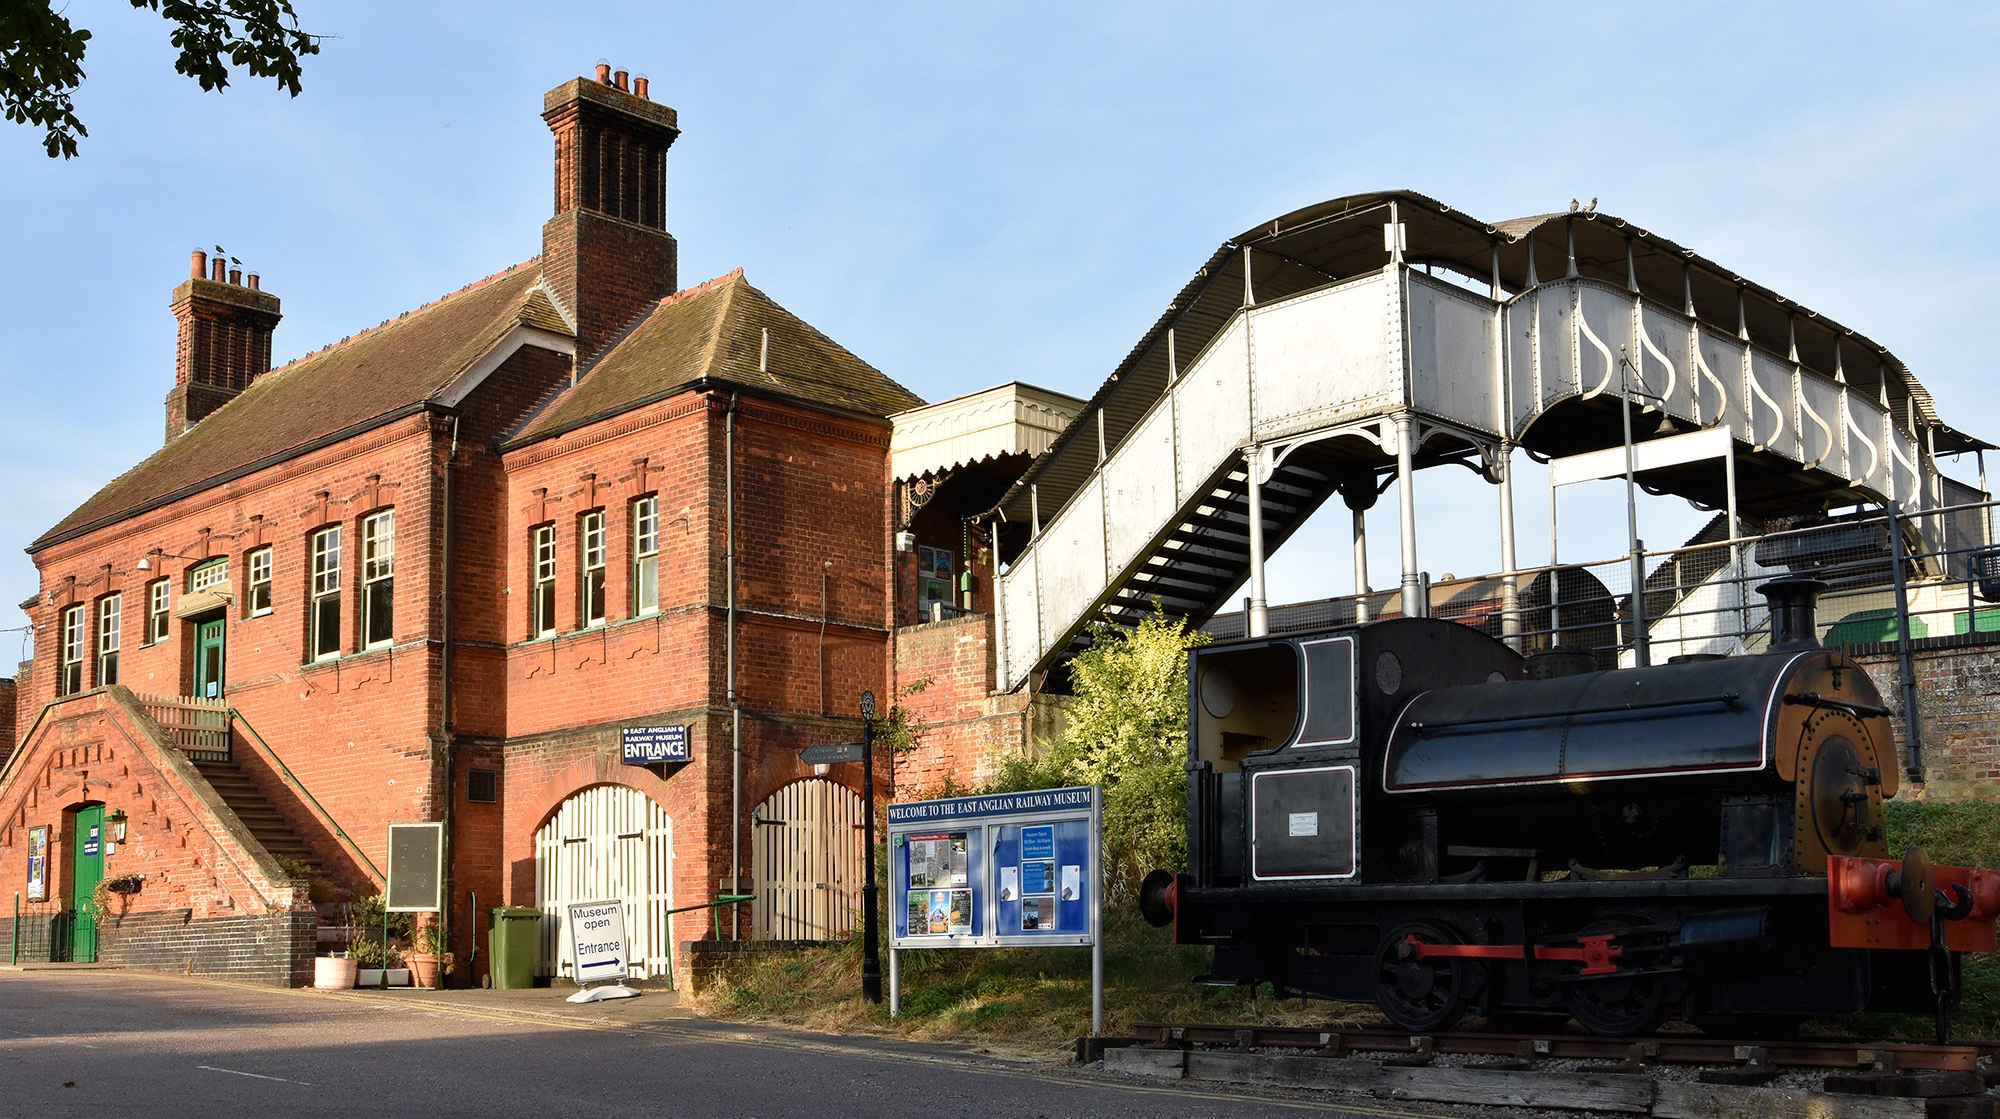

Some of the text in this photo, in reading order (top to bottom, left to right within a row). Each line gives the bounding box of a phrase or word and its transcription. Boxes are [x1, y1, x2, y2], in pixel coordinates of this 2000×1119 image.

[624, 742, 684, 758] ENTRANCE
[889, 791, 1091, 820] WELCOME TO THE EAST ANGLIAN RAILWAY MUSEUM
[574, 906, 617, 918] Museum
[584, 919, 611, 930] open
[578, 941, 620, 955] Entrance
